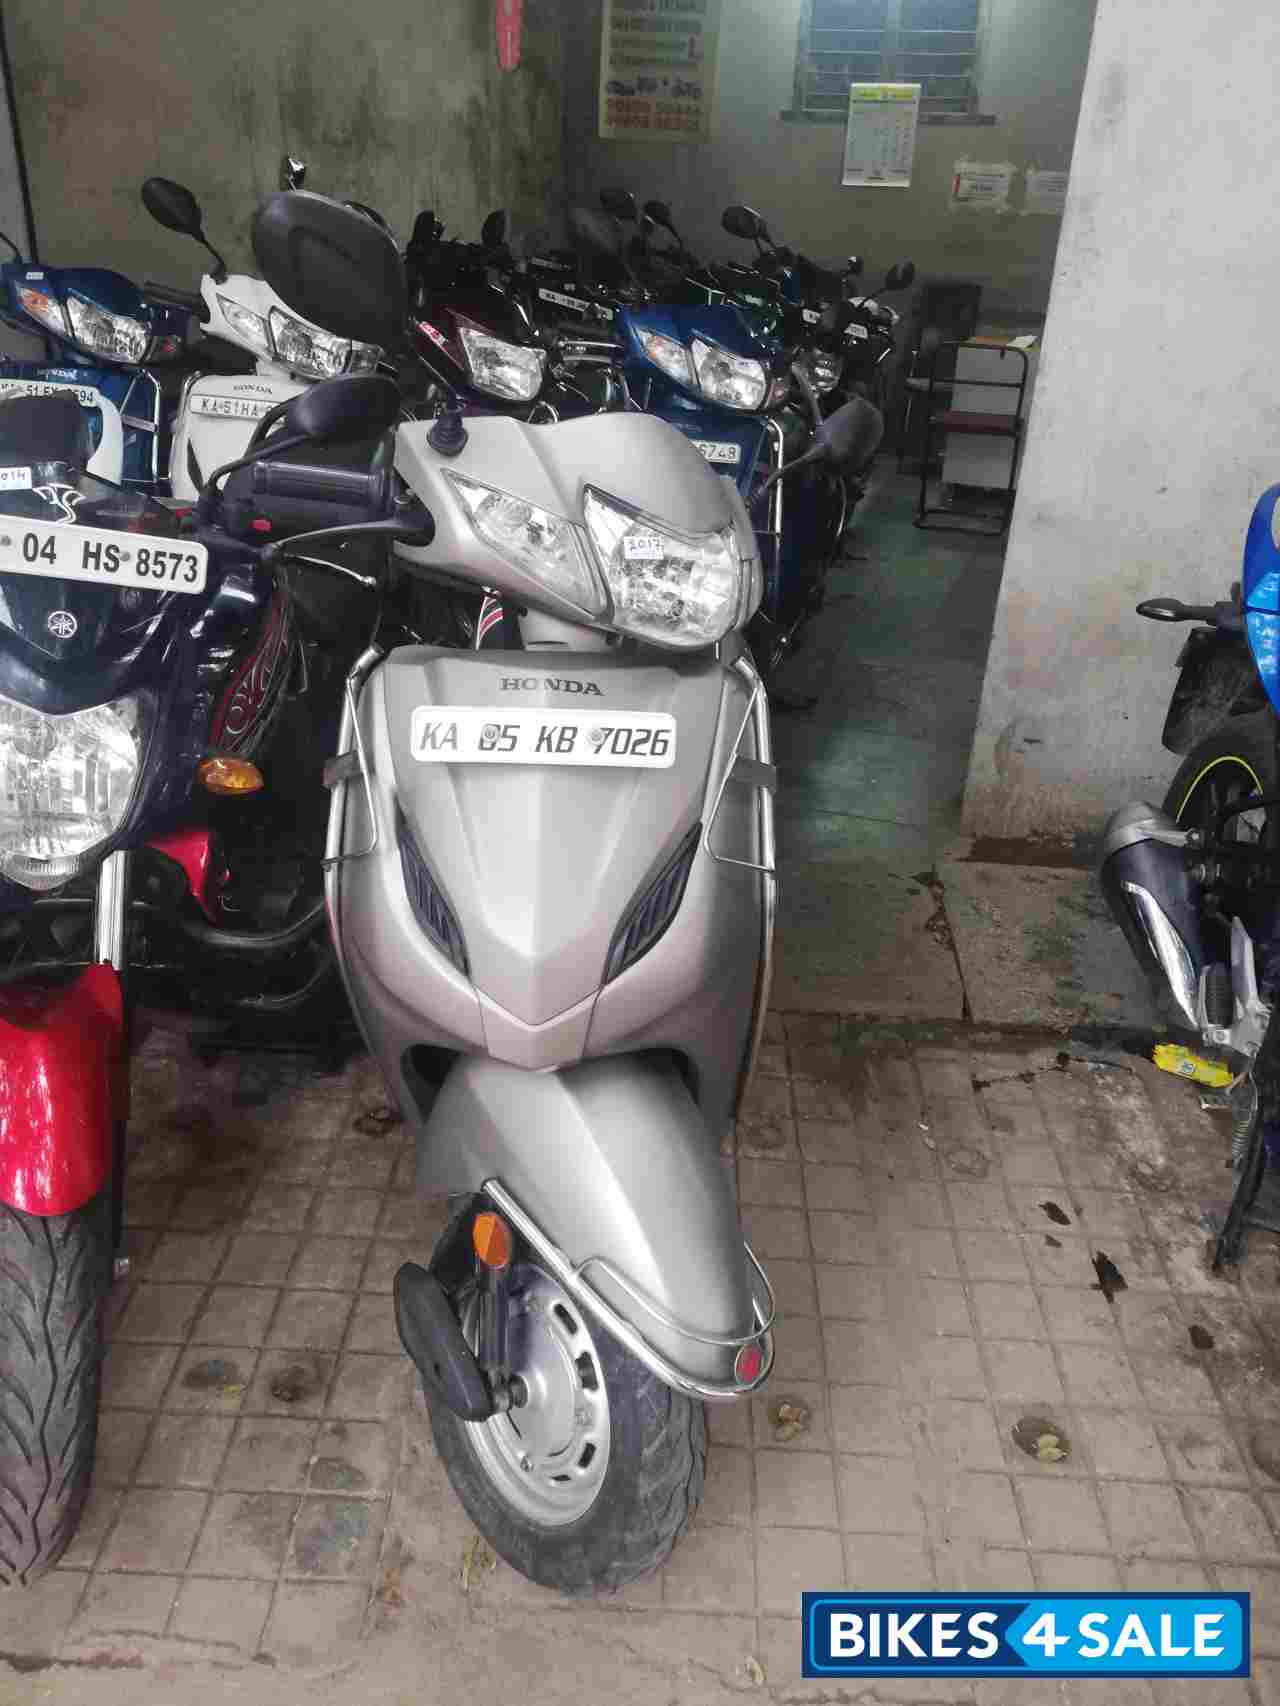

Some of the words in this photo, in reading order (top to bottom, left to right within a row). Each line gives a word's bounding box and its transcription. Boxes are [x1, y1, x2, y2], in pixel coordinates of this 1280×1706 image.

[22, 532, 57, 565] 04
[81, 540, 121, 574] HS
[135, 548, 199, 583] 8573
[499, 677, 606, 697] HONDA
[420, 722, 458, 751] KA
[477, 723, 521, 752] 05
[534, 725, 578, 753] KB
[594, 726, 673, 756] 7026
